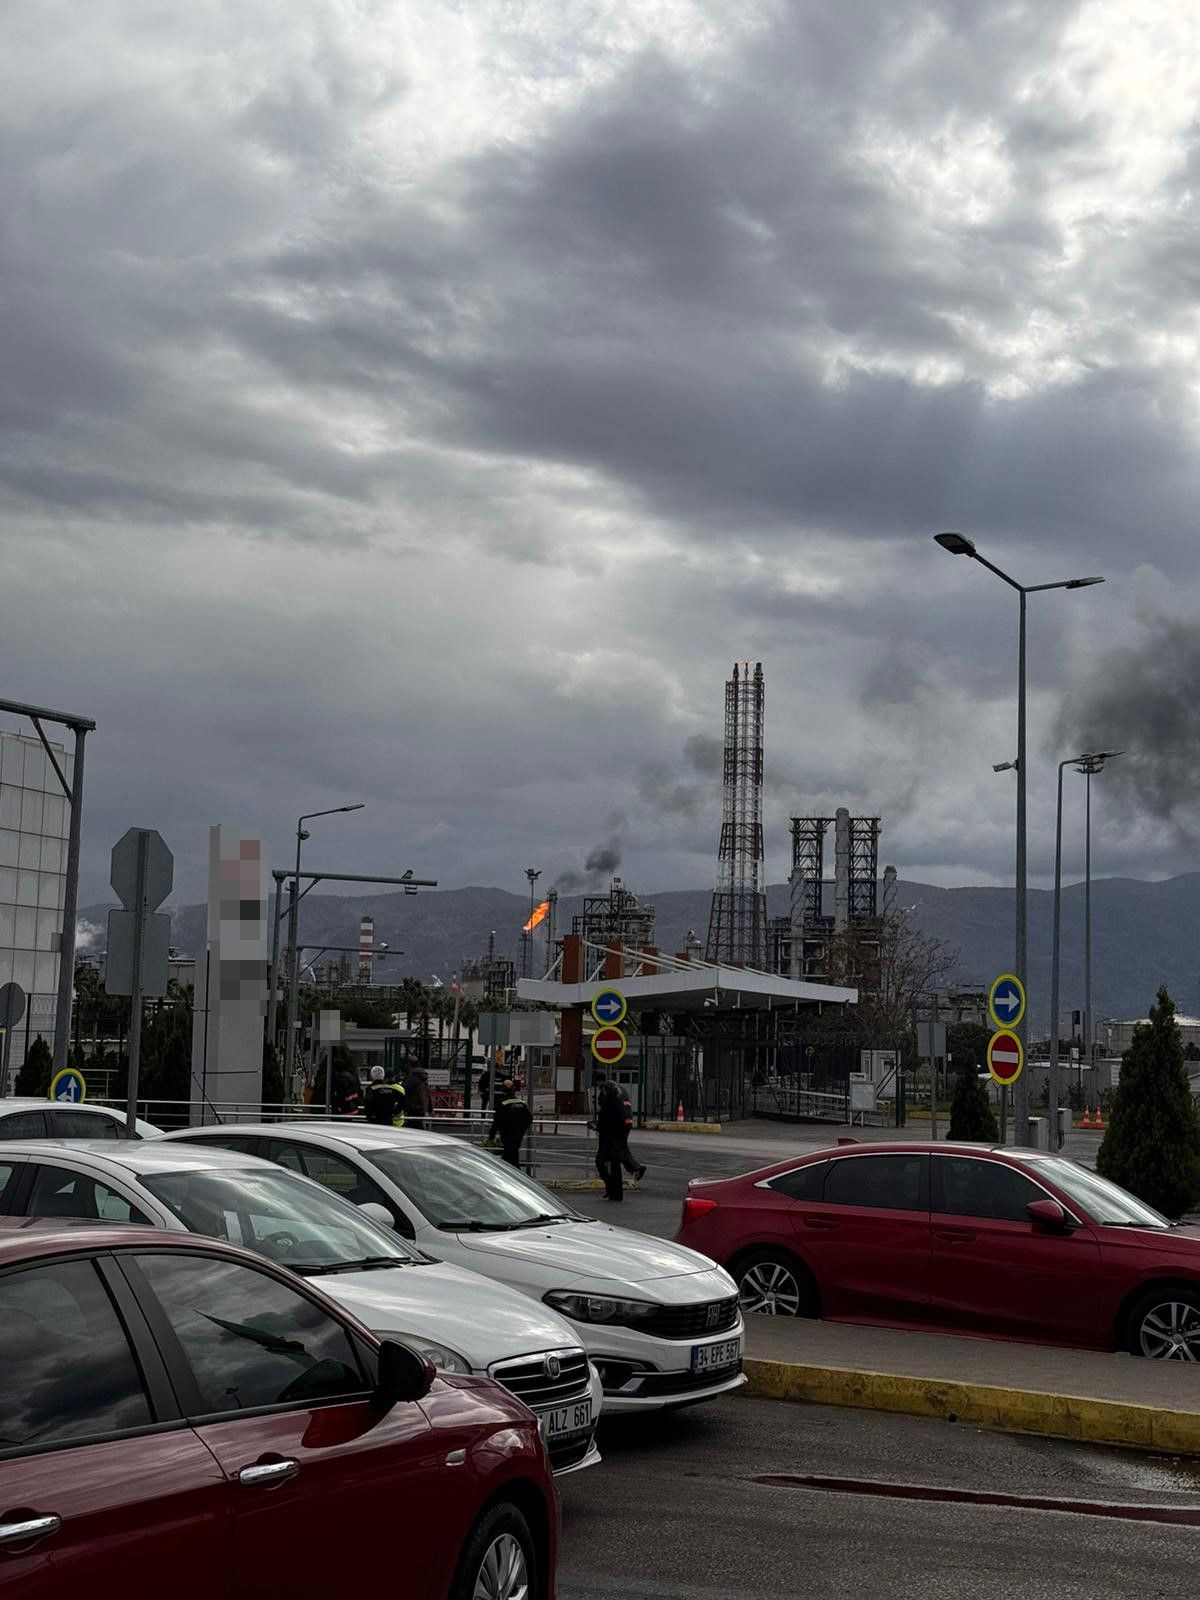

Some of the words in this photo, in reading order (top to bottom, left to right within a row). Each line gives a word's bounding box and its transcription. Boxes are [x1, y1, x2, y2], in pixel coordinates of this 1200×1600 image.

[699, 1349, 708, 1366] 34
[711, 1345, 724, 1364] EPE
[548, 1409, 568, 1434] ALZ
[574, 1404, 589, 1427] 661
